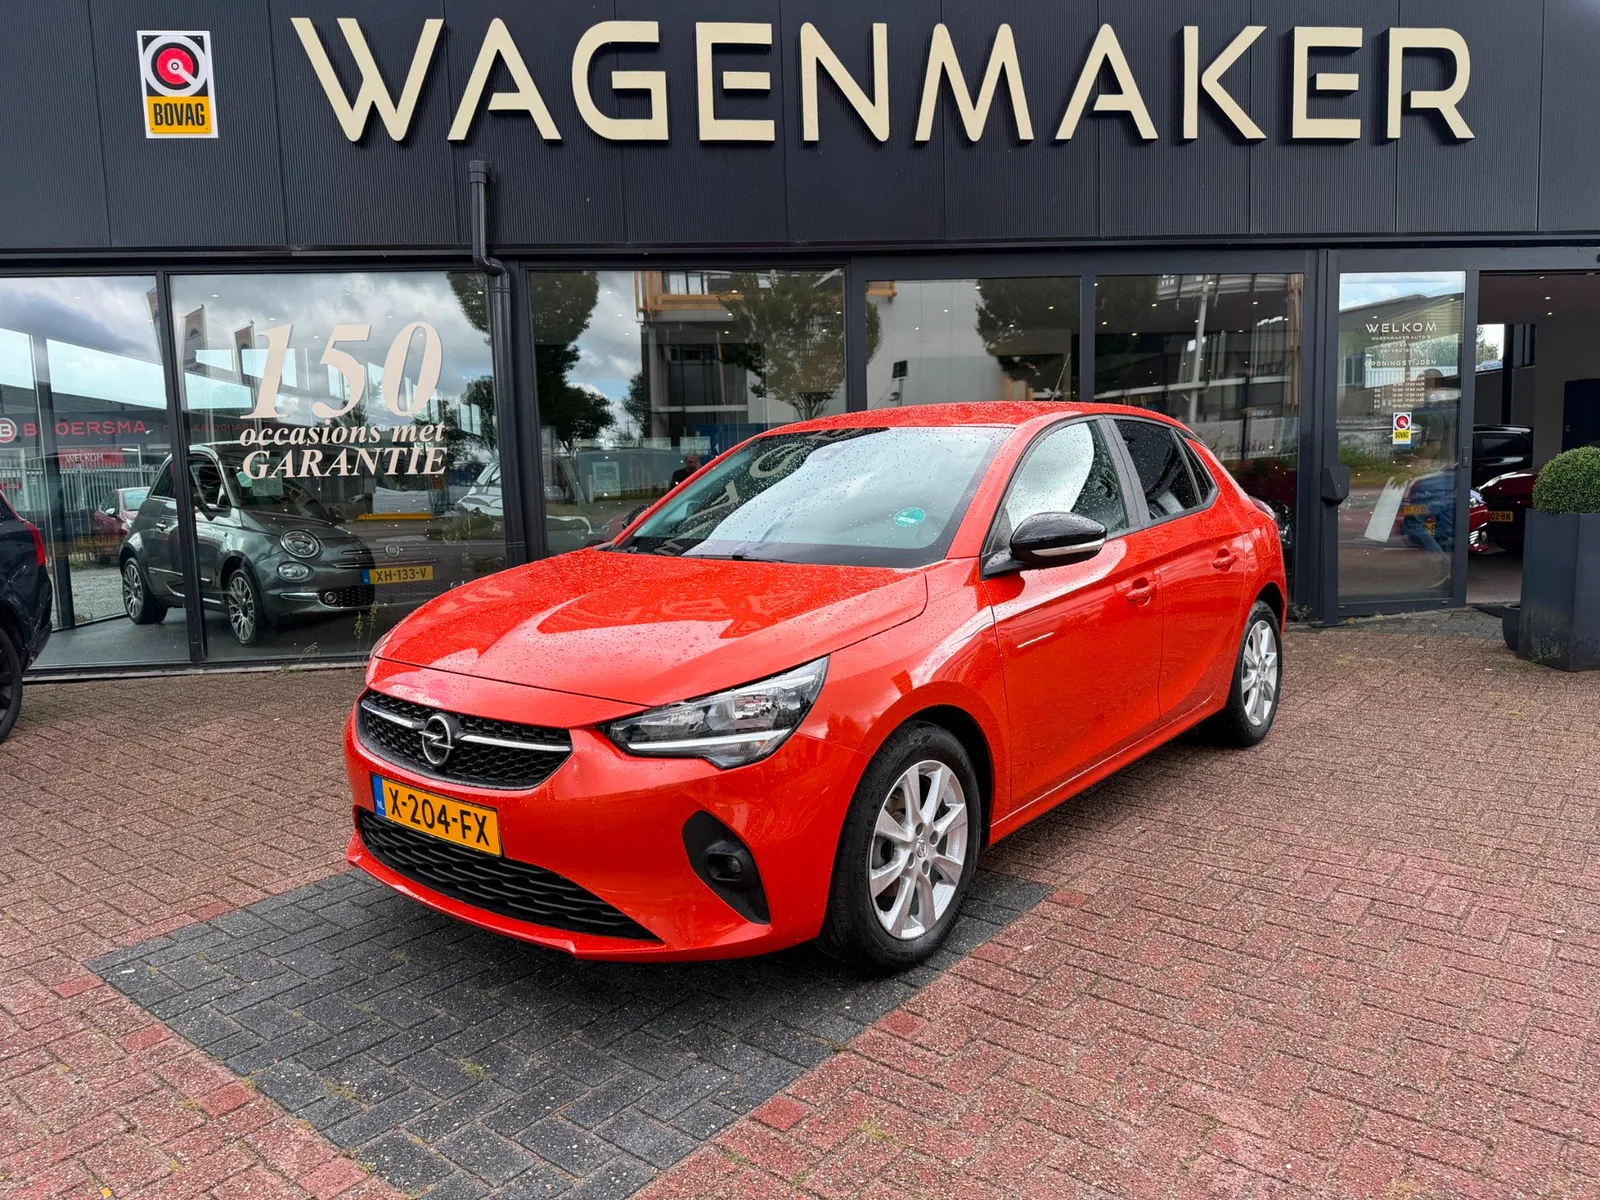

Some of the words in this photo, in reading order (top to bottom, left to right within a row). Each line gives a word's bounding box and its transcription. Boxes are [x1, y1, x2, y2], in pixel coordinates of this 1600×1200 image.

[291, 18, 1475, 142] WAGENMAKER
[153, 103, 205, 126] BOVAG
[1365, 322, 1437, 334] WELKOM
[240, 321, 443, 419] 150
[23, 420, 147, 437] BOERSMA
[240, 418, 381, 447] occasions
[391, 420, 446, 444] met
[65, 453, 104, 463] WELKOM
[242, 447, 448, 480] GARANTIE
[376, 567, 427, 583] XH-133-V
[389, 786, 491, 847] X-204-FX
